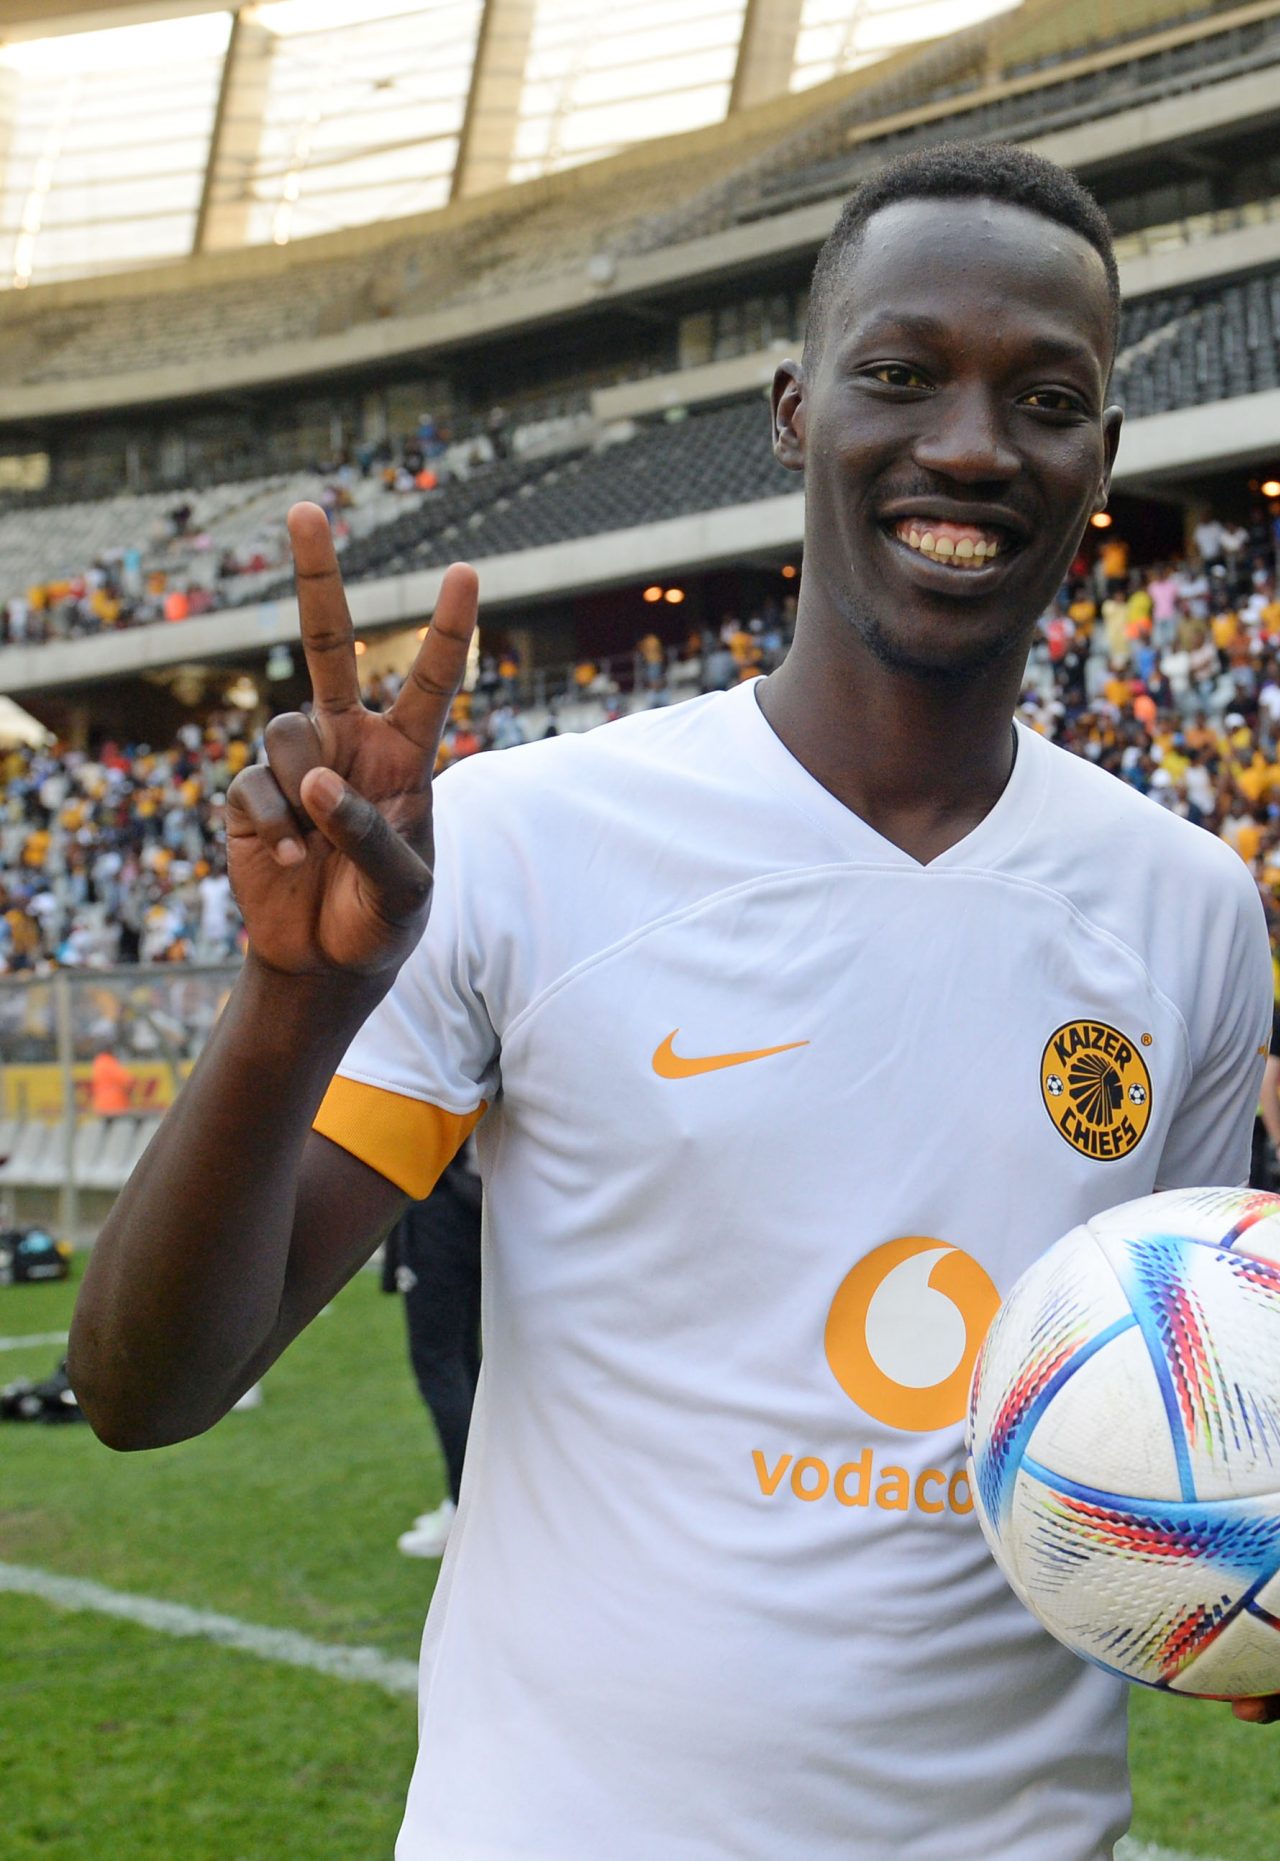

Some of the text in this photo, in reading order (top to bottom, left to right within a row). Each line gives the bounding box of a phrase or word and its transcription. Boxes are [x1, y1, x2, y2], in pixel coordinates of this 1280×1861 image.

[1053, 1025, 1133, 1073] KAIZER
[1059, 1106, 1138, 1156] CHIEFS
[752, 1447, 975, 1515] vodaco
